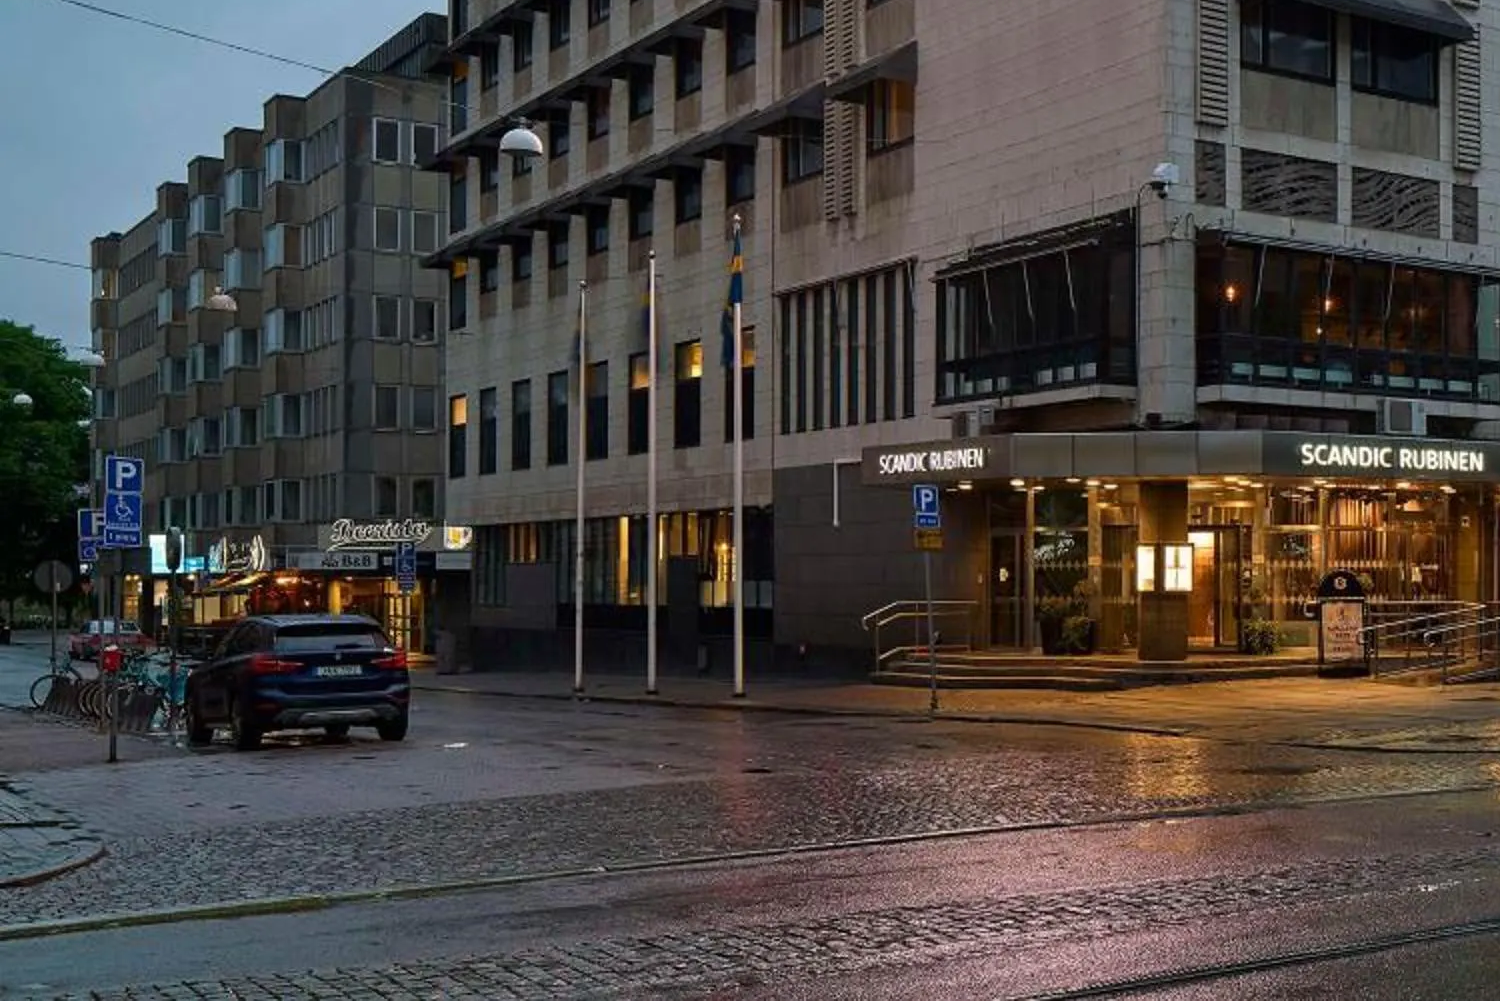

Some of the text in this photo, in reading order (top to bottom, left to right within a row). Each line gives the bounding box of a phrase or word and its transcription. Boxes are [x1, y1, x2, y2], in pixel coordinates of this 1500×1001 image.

[879, 446, 984, 475] SCANDIC RUBINEN
[1300, 443, 1486, 472] SCANDIC RUBINEN
[115, 460, 137, 488] P
[920, 488, 934, 511] P
